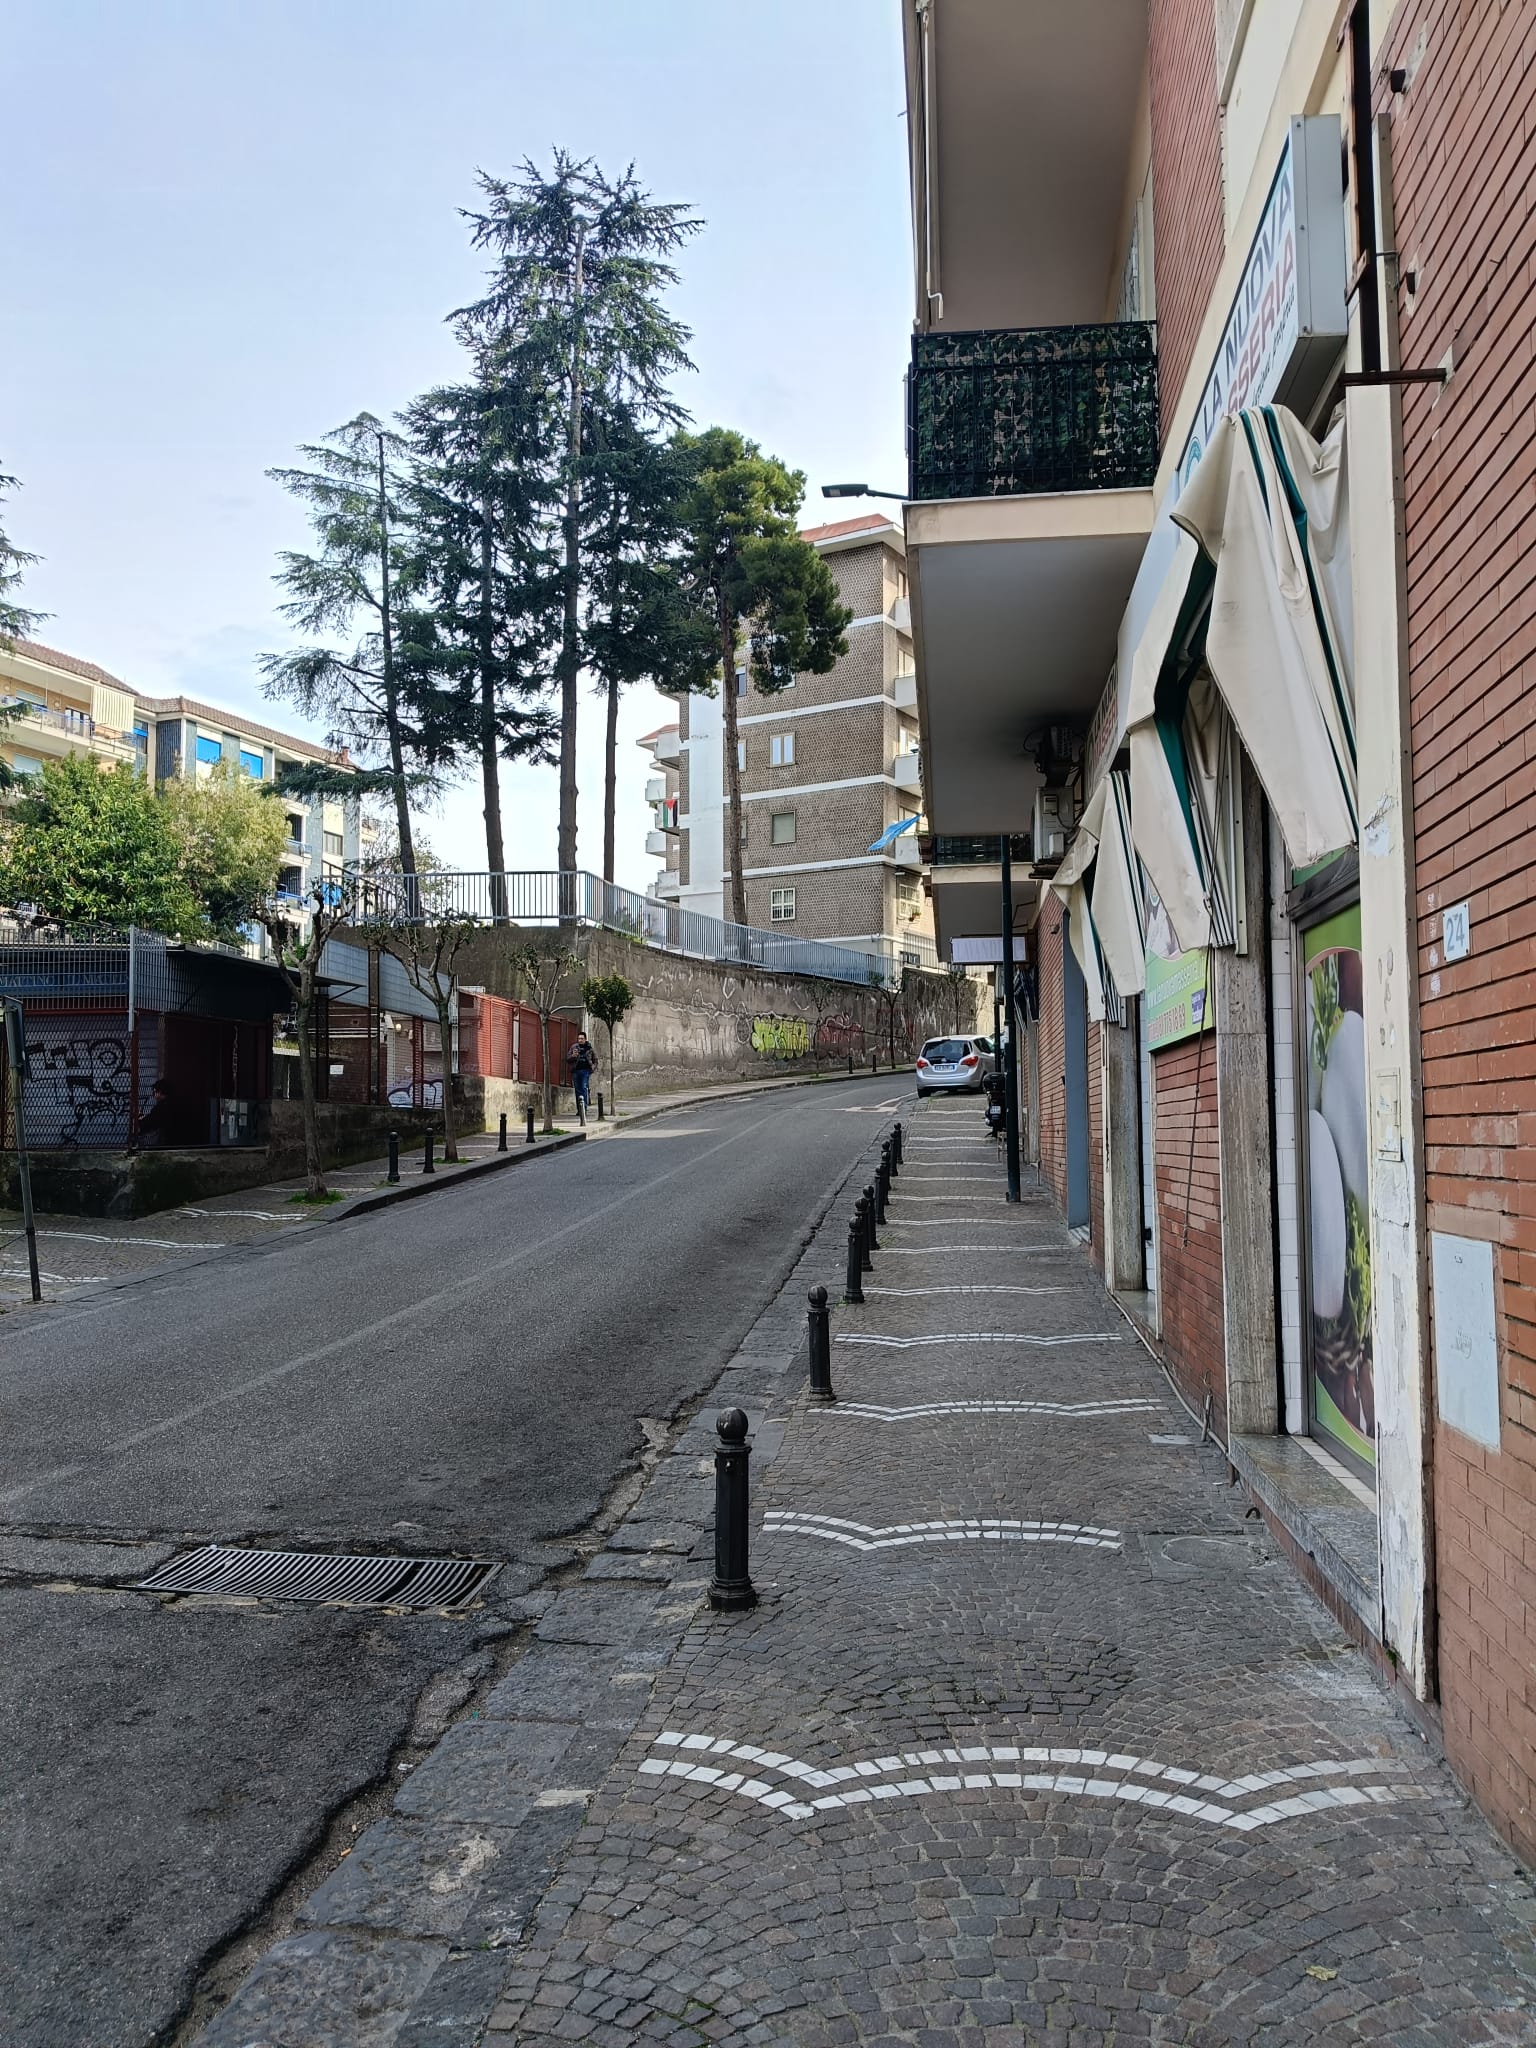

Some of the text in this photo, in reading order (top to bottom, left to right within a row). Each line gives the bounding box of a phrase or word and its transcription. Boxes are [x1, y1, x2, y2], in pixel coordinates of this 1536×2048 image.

[1204, 373, 1222, 445] LA
[1226, 171, 1292, 384] NUOVA
[1224, 231, 1295, 419] SSERIA
[1446, 912, 1465, 953] 24
